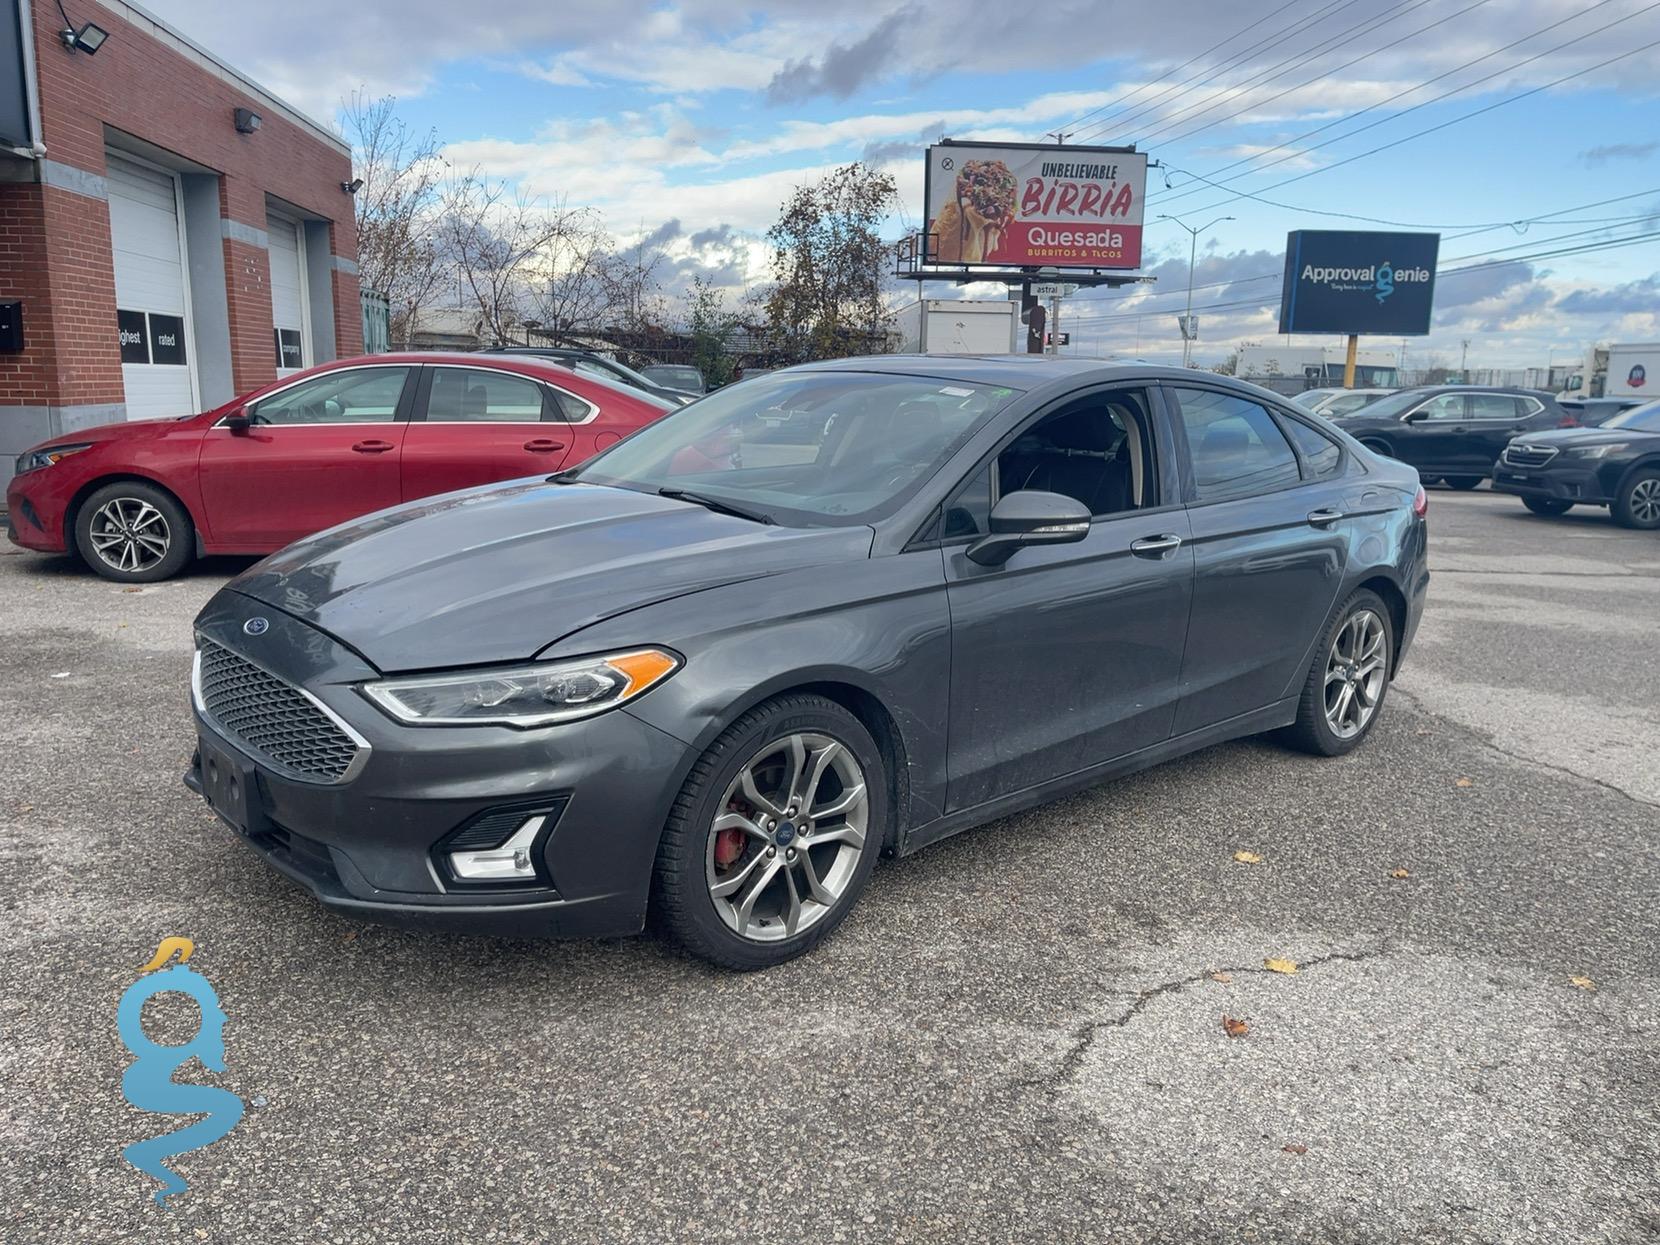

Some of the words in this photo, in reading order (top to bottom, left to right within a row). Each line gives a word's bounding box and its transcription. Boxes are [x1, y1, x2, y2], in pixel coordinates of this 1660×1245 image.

[1042, 162, 1118, 180] UNBELIEVABLE
[1027, 227, 1123, 248] Quesada
[1027, 248, 1077, 257] BURRITOS
[118, 329, 141, 346] ighest
[158, 333, 175, 346] rated
